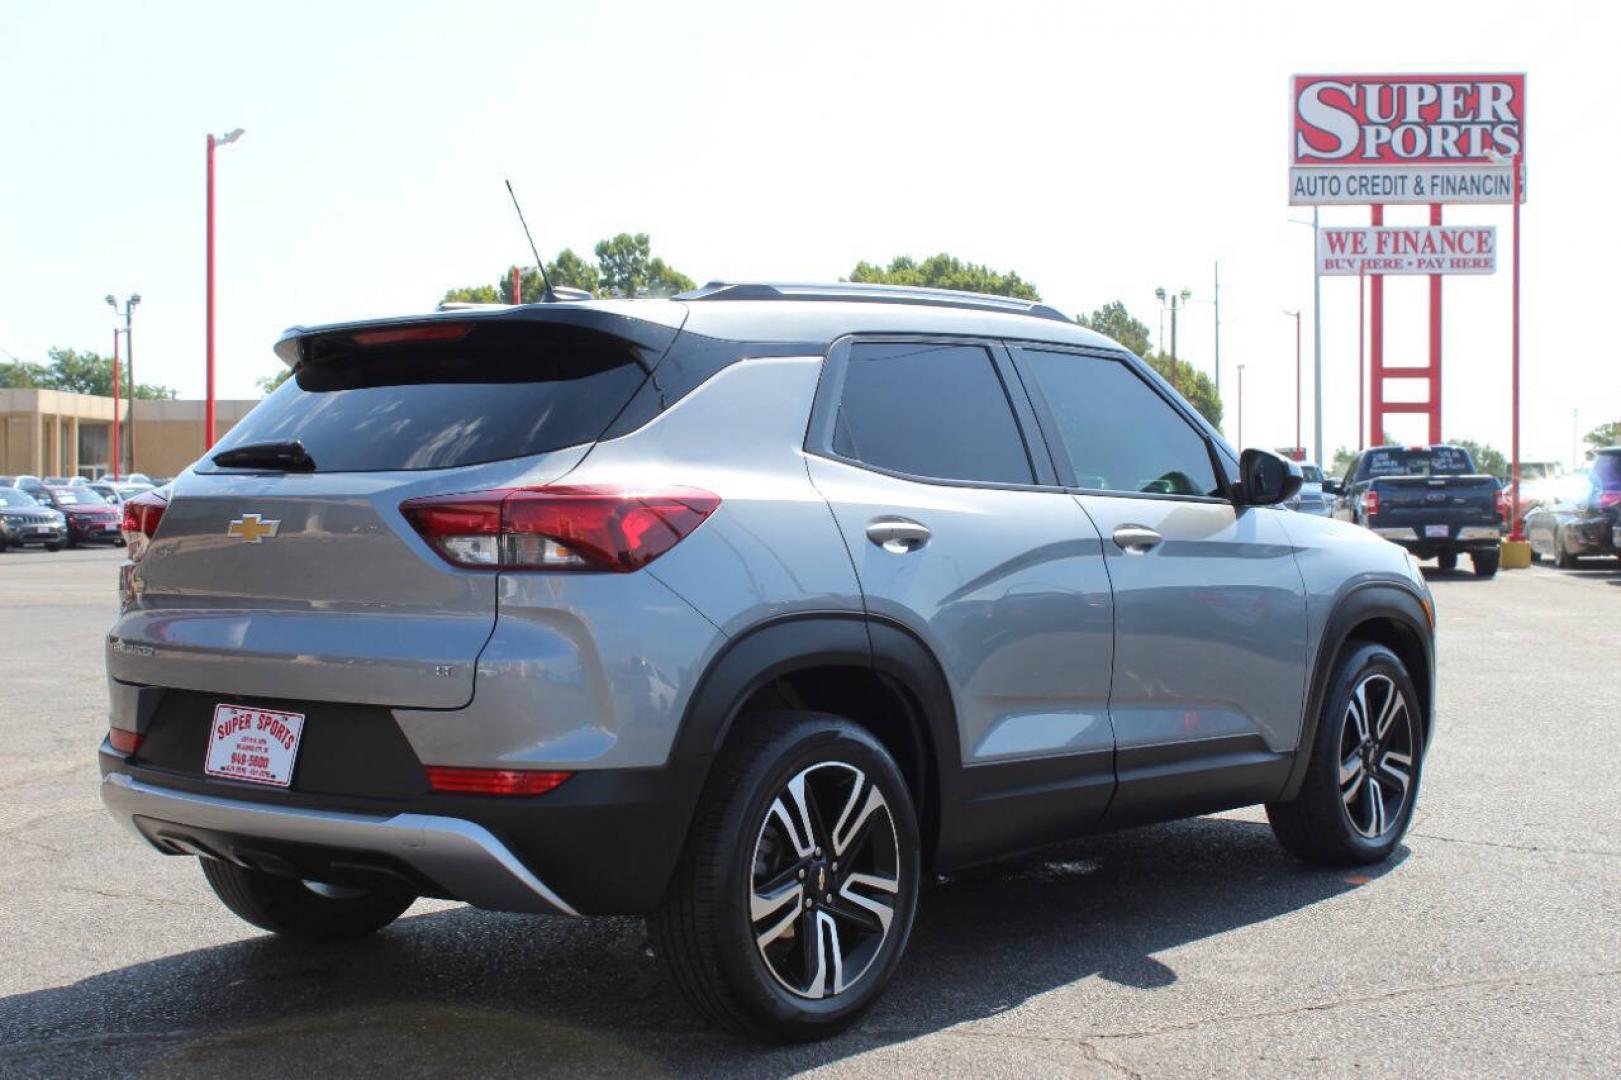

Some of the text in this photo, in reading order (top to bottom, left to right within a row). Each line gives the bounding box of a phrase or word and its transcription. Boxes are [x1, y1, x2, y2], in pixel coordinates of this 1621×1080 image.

[1297, 80, 1518, 160] SUPER
[1294, 176, 1341, 196] AUTO
[1346, 175, 1408, 196] CREDIT
[1413, 175, 1425, 196] &
[1324, 230, 1493, 255] WE FINANCE
[1324, 257, 1493, 270] BUY HERE PAY HERE
[218, 713, 295, 750] SUPER SPORTS
